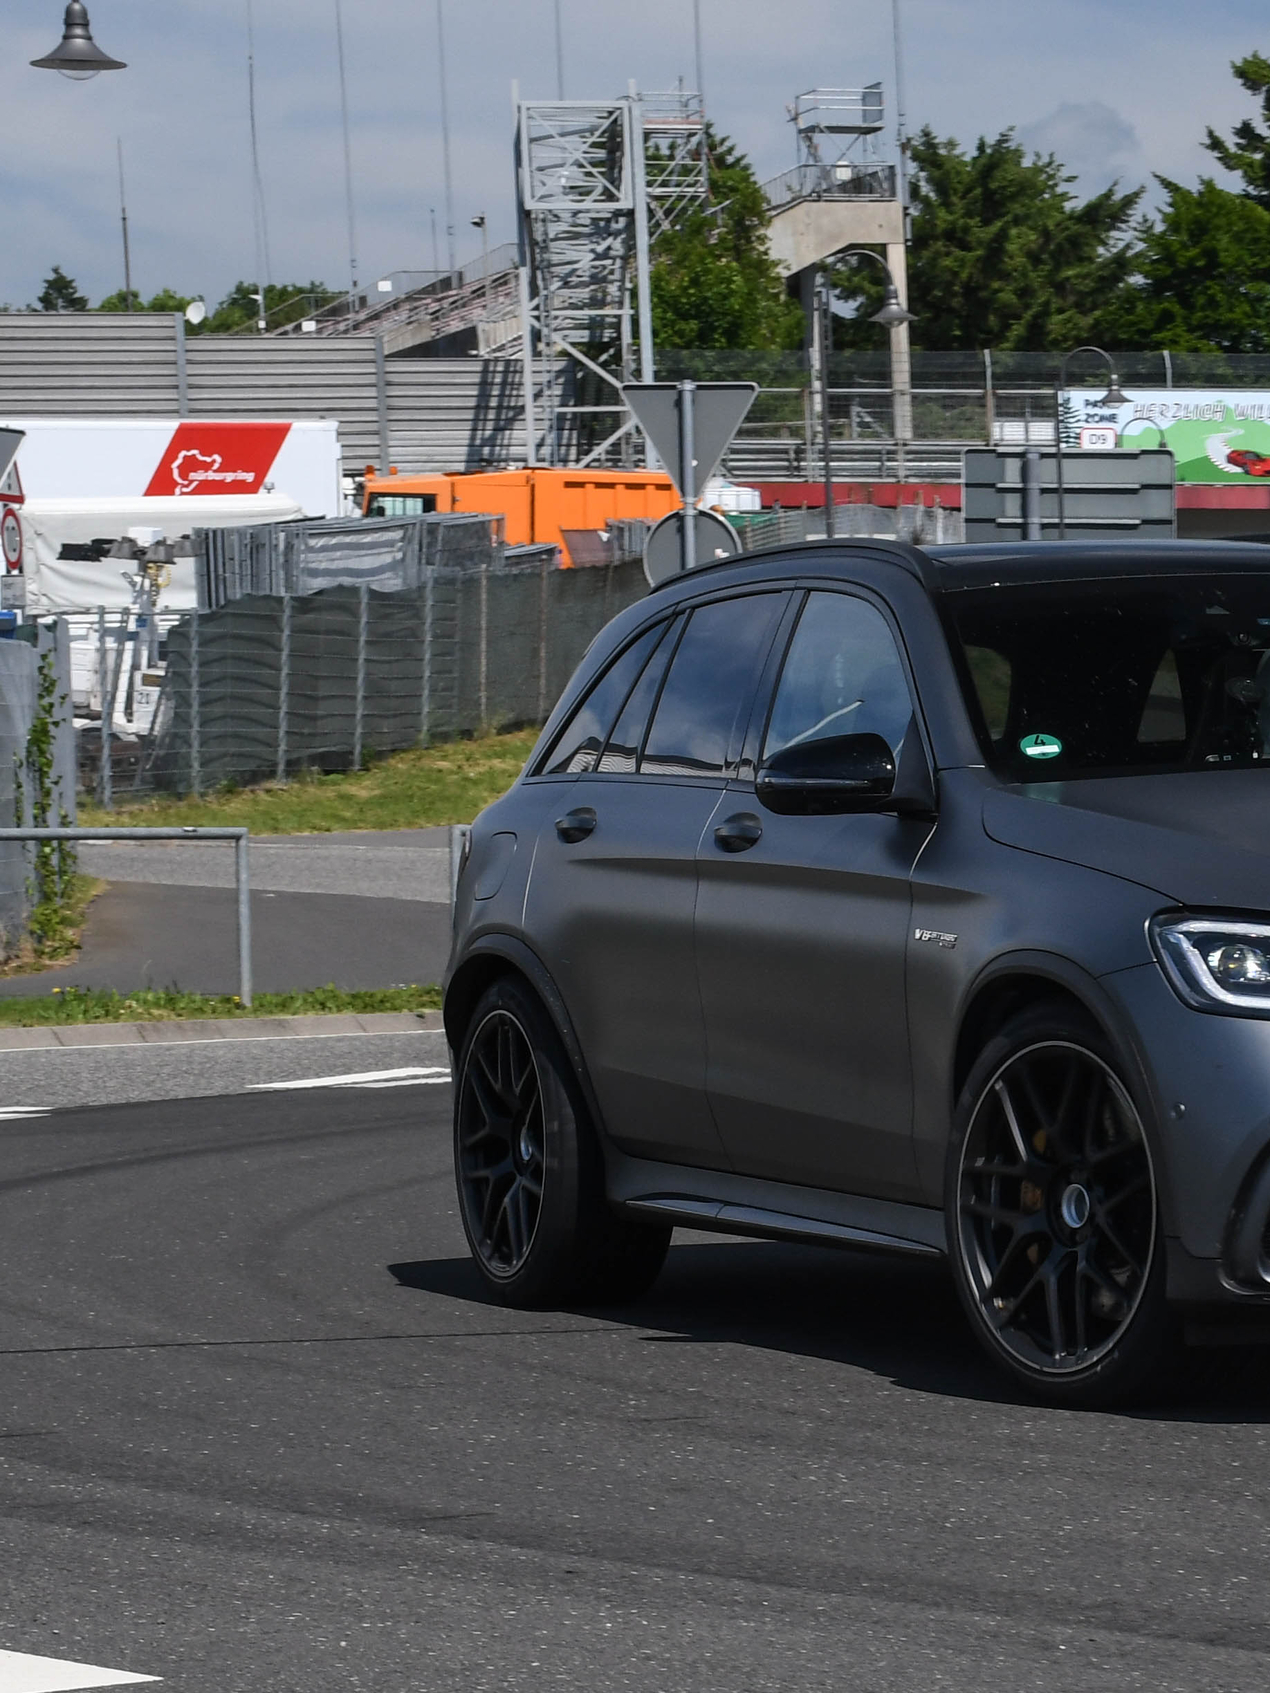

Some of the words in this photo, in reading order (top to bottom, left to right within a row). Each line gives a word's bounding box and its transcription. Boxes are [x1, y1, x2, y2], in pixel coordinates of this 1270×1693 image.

[1133, 402, 1226, 422] HERZLICH
[1084, 413, 1119, 424] ZONE
[1034, 734, 1047, 746] 4
